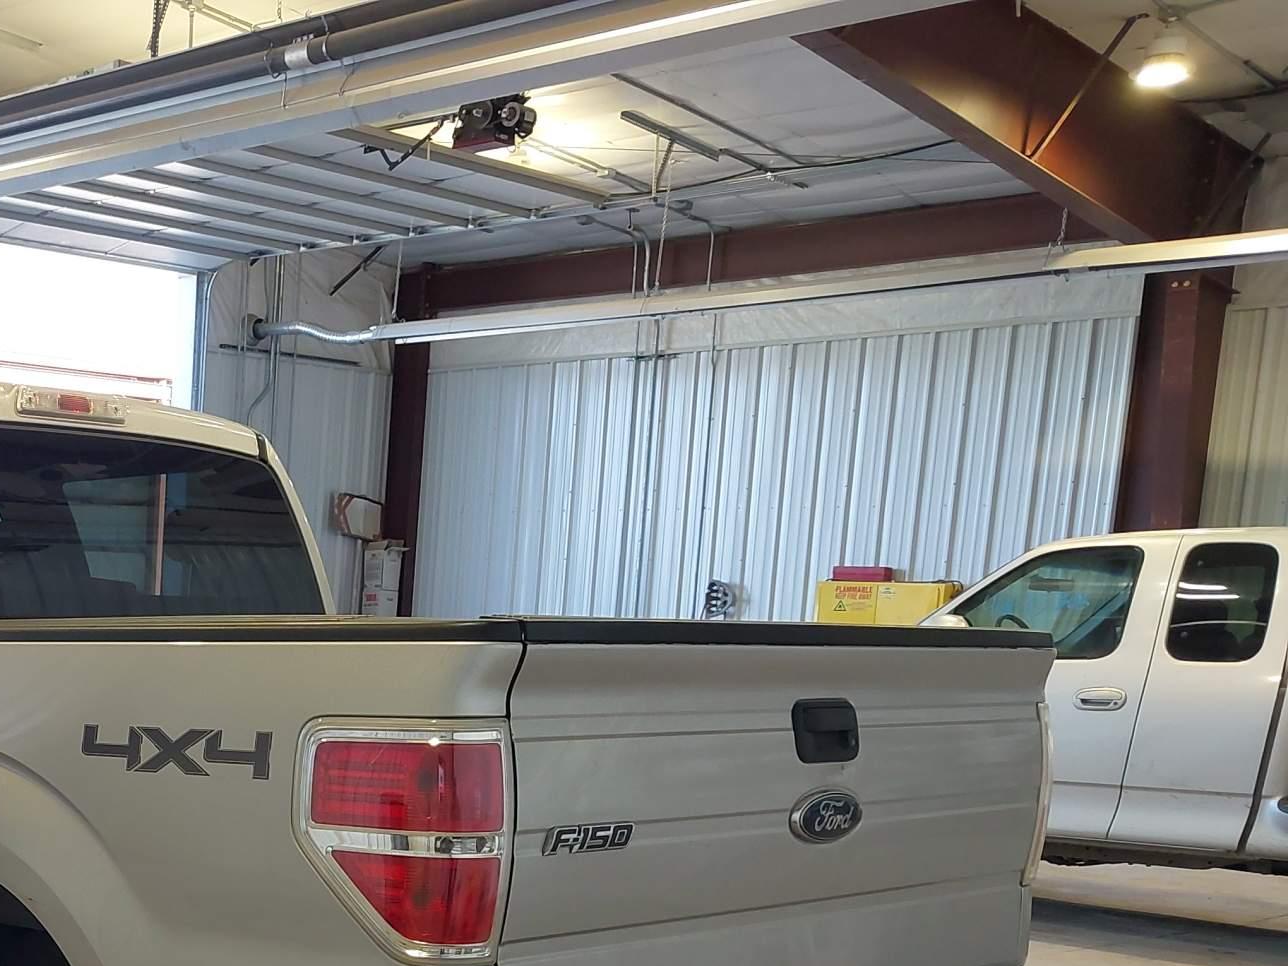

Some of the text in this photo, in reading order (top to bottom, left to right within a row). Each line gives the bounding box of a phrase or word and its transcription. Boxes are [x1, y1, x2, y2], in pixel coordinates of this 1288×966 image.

[835, 586, 872, 594] FLAMMABLE
[814, 800, 855, 832] Ford
[542, 822, 635, 856] F-150
